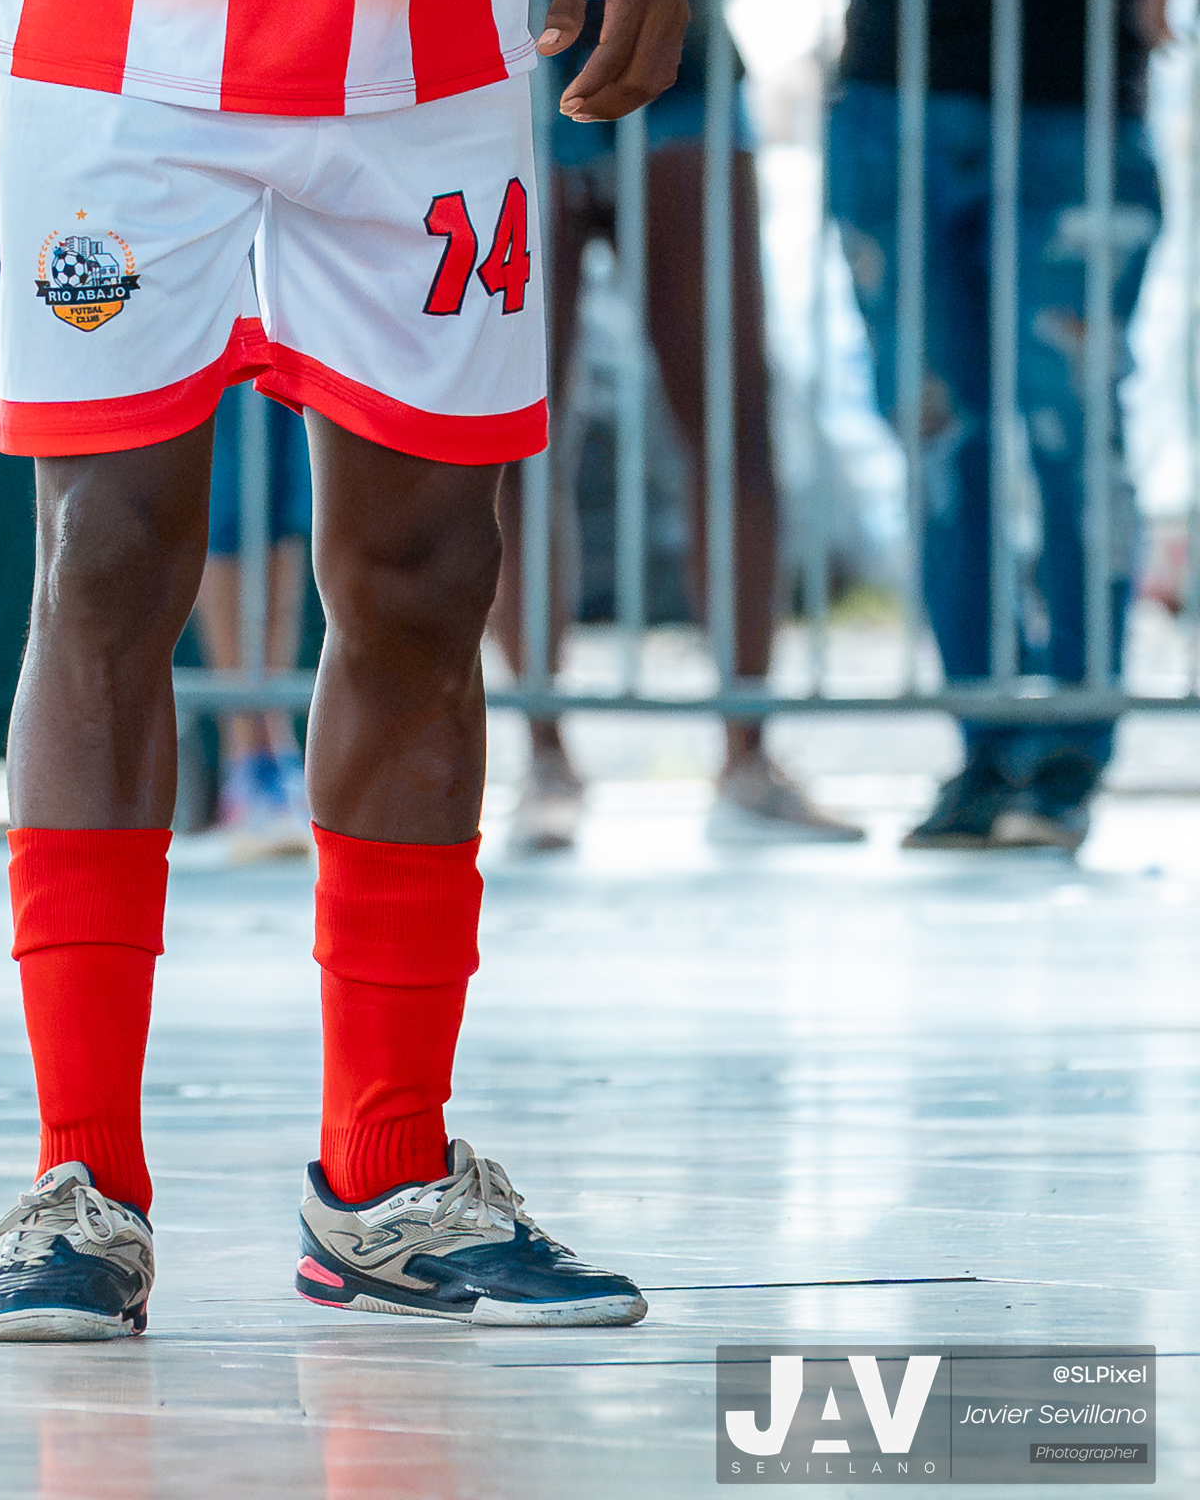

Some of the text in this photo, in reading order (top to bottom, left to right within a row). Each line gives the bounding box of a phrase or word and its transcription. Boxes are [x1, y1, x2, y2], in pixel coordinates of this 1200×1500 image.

[422, 177, 531, 316] 14
[48, 286, 126, 302] RIO ABAJO
